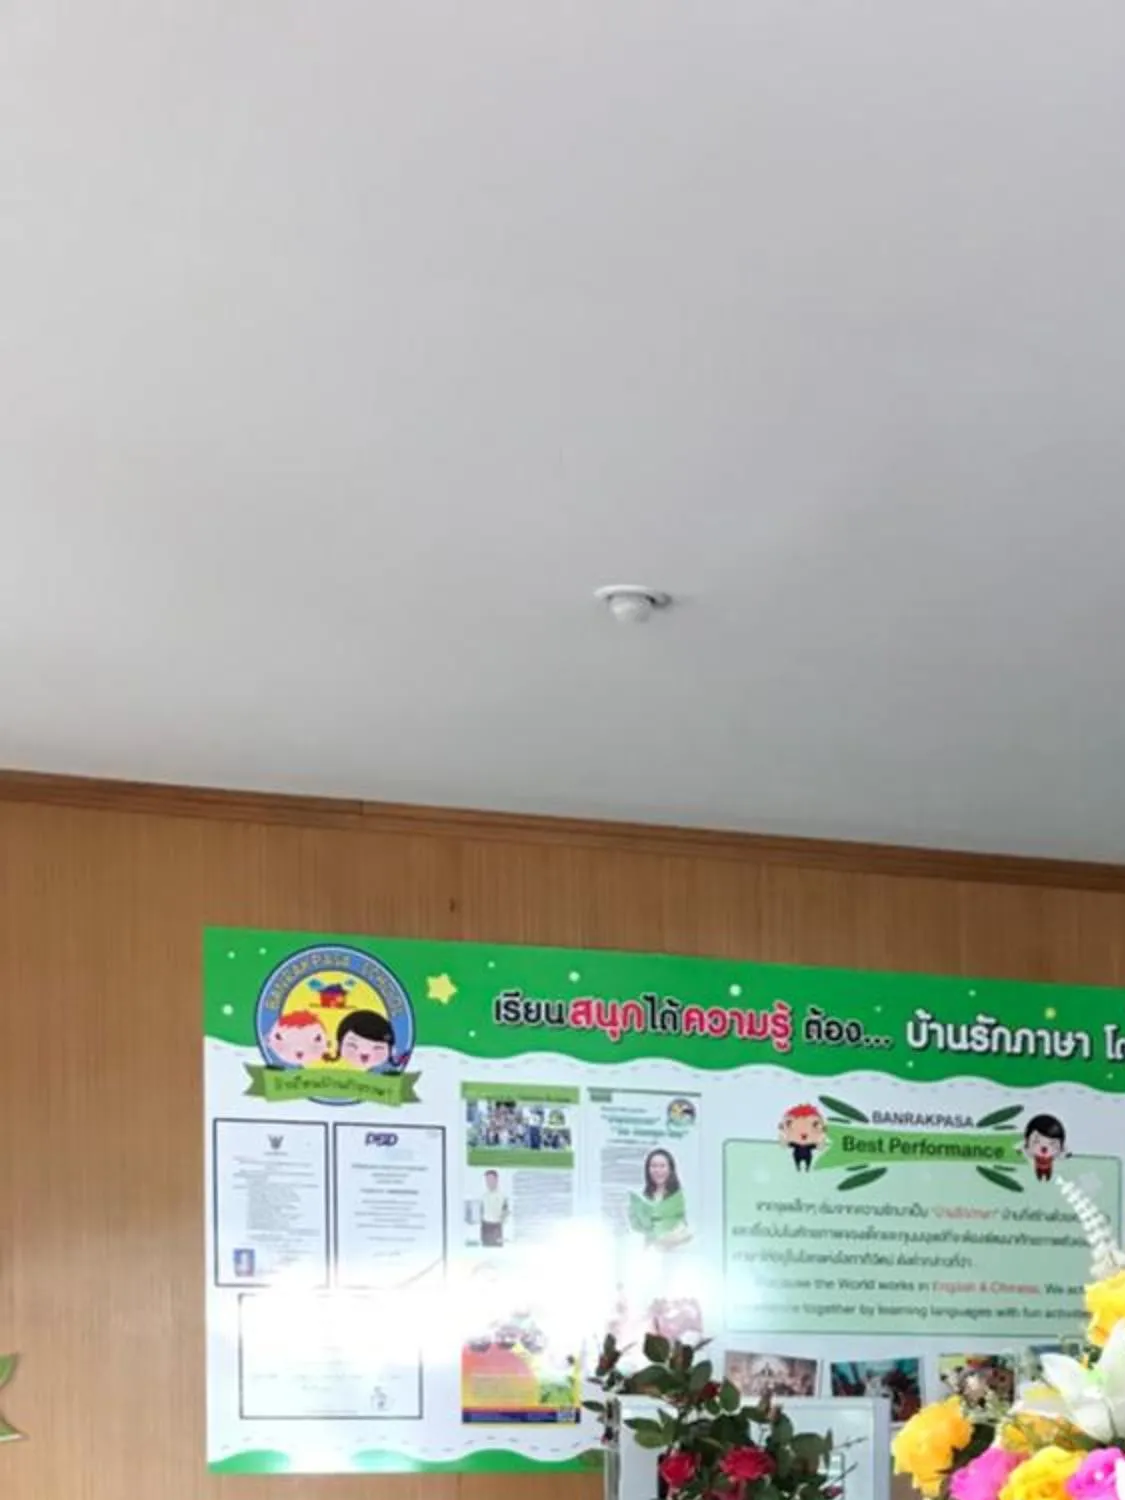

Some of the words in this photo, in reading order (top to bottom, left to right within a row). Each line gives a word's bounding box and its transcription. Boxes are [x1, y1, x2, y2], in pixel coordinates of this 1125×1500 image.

[905, 1009, 1092, 1059] บ้านรักภาษา
[872, 1110, 975, 1128] BANRAKPASA
[842, 1135, 884, 1153] Best
[889, 1137, 1006, 1160] Performance
